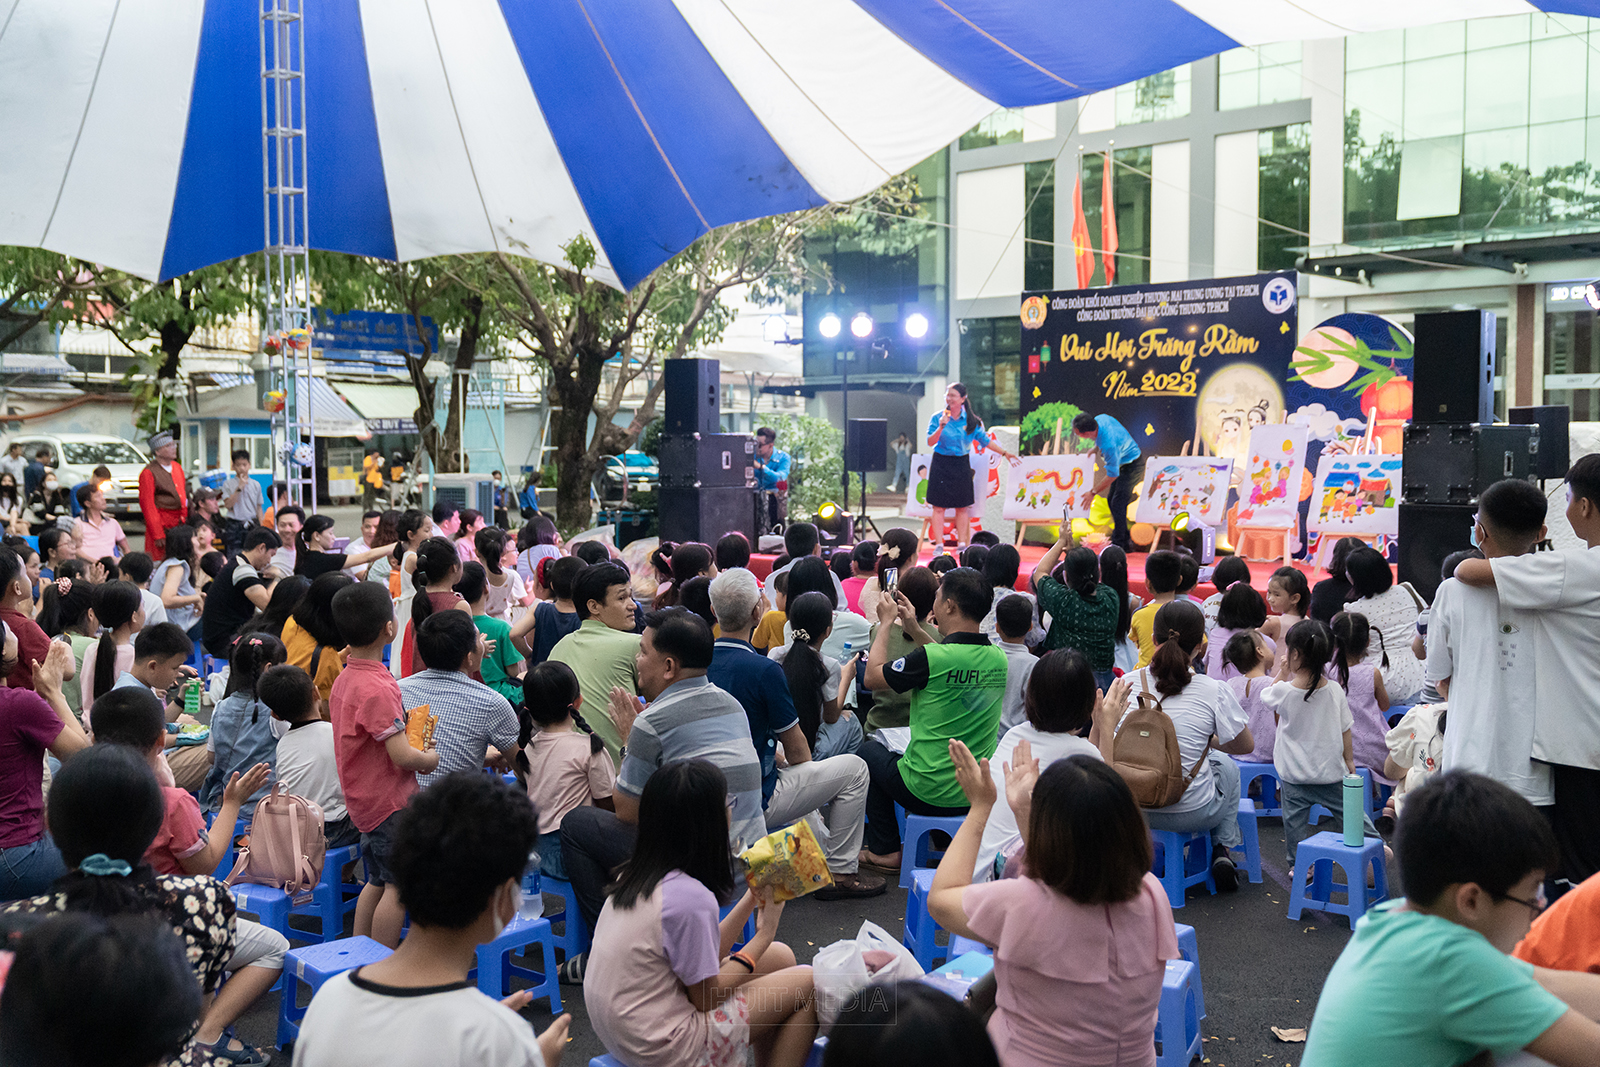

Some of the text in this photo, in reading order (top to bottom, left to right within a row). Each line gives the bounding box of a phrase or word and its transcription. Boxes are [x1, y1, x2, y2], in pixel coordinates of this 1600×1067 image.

[1052, 296, 1068, 310] CÔNG
[1068, 295, 1085, 309] ĐOÀN
[1085, 292, 1100, 308] KHỐI
[1100, 294, 1121, 307] DOANH
[1183, 287, 1204, 301] TRUNG
[1236, 284, 1260, 298] TP.HCM
[1076, 308, 1094, 322] CÔNG
[1094, 307, 1110, 321] ĐOÀN
[1206, 300, 1230, 313] TP.HCM
[1095, 331, 1136, 363] Hội
[1138, 328, 1197, 373] Trăng
[1199, 323, 1260, 357] Rằm
[1102, 370, 1197, 400] Năm 2023
[946, 669, 980, 684] HUFI
